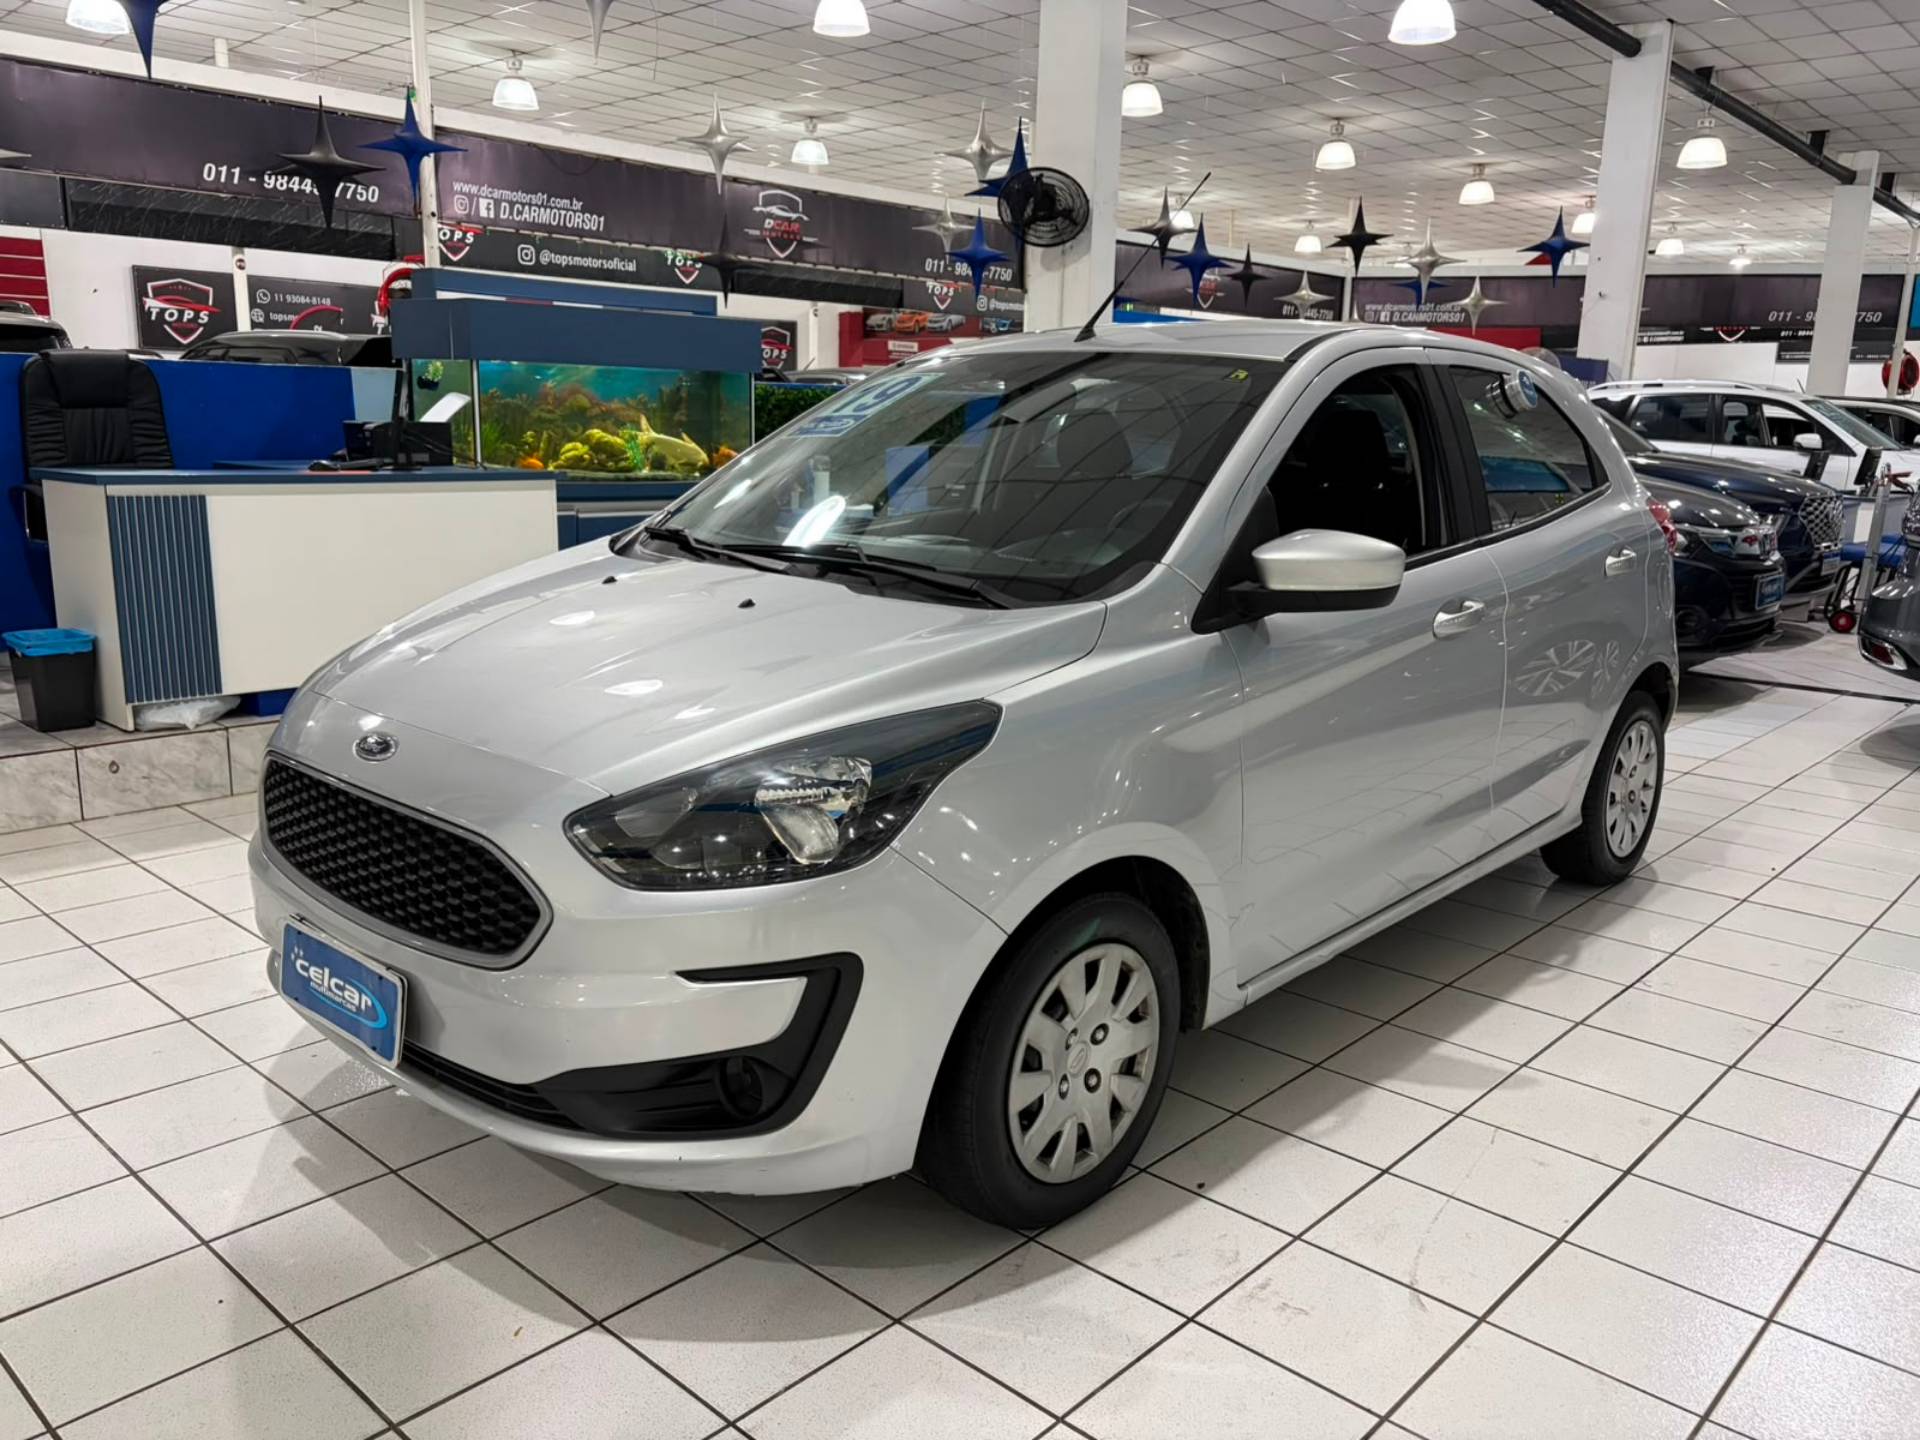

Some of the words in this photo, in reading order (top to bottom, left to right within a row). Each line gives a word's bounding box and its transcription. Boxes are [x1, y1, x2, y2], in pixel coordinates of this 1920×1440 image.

[203, 162, 241, 185] 011
[453, 181, 583, 211] www.dcarmotors01.com.br
[500, 202, 605, 232] D.CARMOTORS01
[439, 228, 475, 244] OPS
[539, 250, 637, 272] @topsmotorsoficial
[925, 258, 944, 273] 011
[149, 307, 210, 324] TOPS
[1768, 311, 1792, 322] 011
[762, 349, 788, 360] OPS
[295, 958, 372, 1011] celcar
